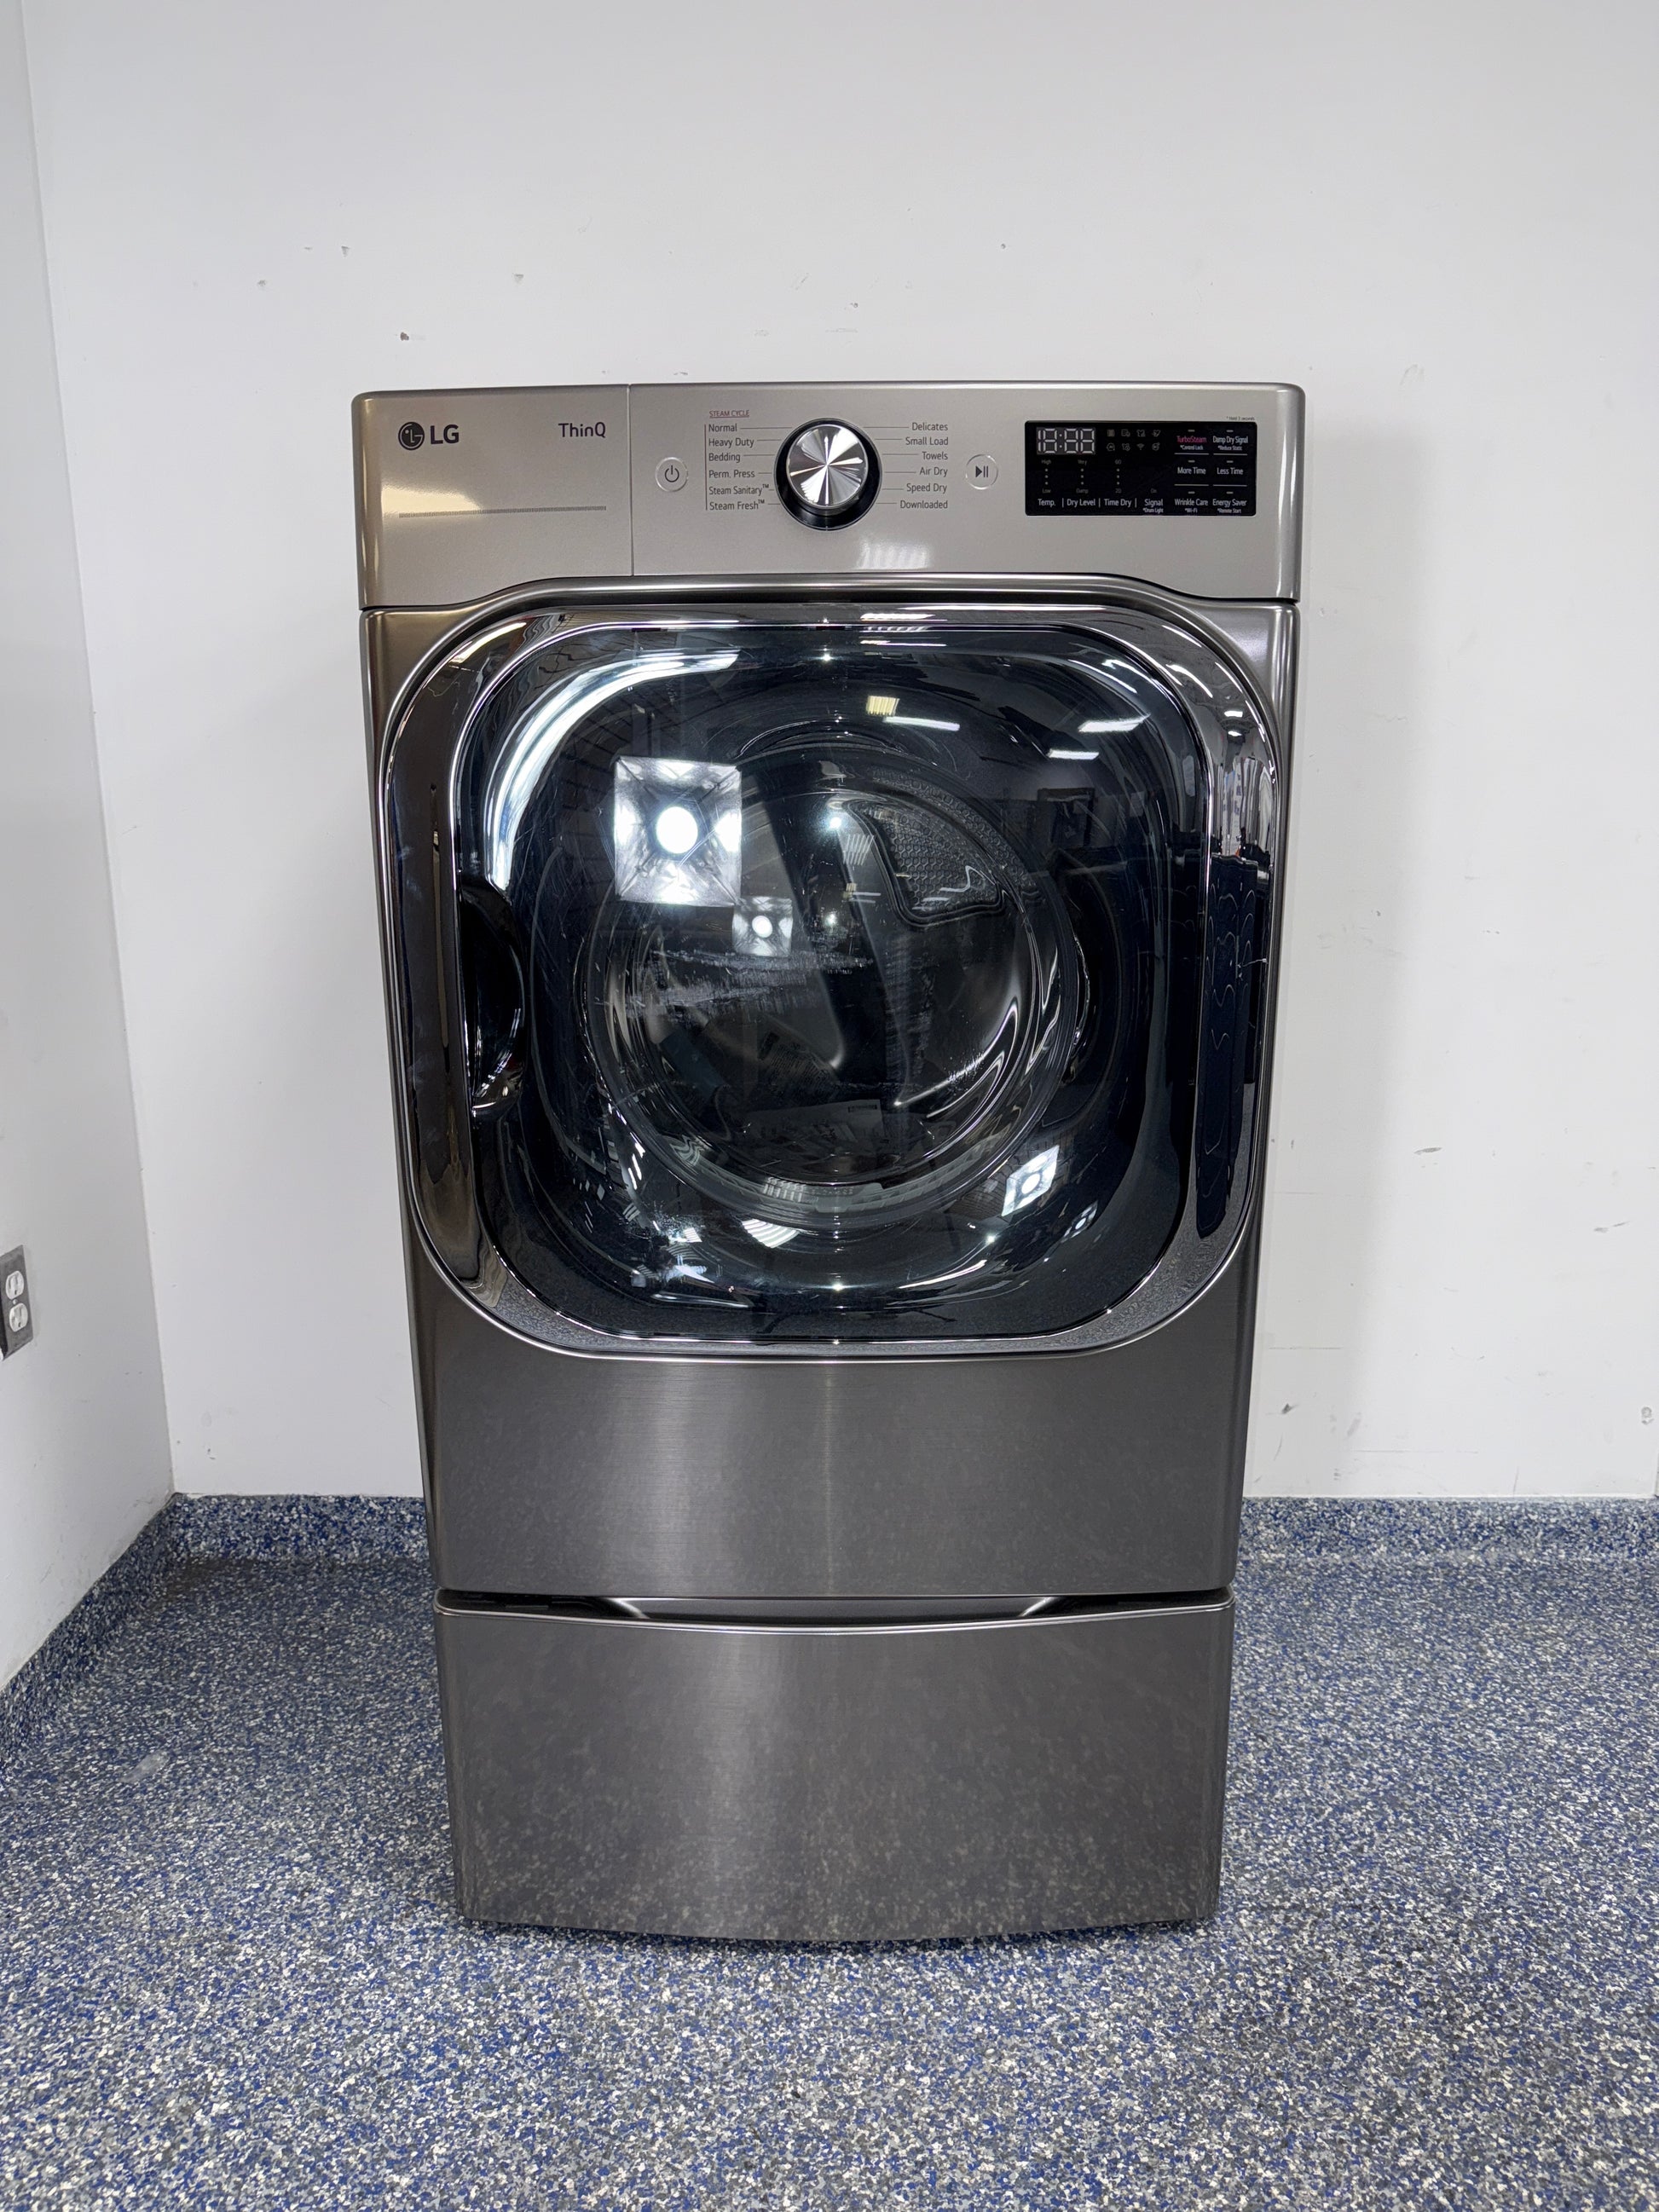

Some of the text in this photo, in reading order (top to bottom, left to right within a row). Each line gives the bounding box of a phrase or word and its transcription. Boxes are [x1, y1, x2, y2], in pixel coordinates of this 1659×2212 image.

[558, 422, 606, 438] ThinQ
[708, 423, 737, 432] Normal
[912, 422, 948, 431] Delicates
[430, 424, 460, 445] LG
[708, 438, 754, 448] Heavy Duty
[905, 436, 948, 445] Small Load
[1213, 436, 1225, 445] Damp
[1235, 436, 1249, 445] Signal
[708, 453, 740, 463] Bedding
[922, 451, 948, 460] Towels
[709, 470, 755, 478] Perm. Press
[919, 466, 948, 477] Air Dry
[709, 486, 731, 495] Steam
[907, 482, 947, 494] Speed Dry
[710, 502, 734, 510] Steam
[900, 500, 948, 508] Downloaded
[1038, 498, 1056, 508] Temp.
[1067, 499, 1078, 508] Dry
[1120, 499, 1132, 508] Dry
[1145, 498, 1163, 507] Signal
[1213, 499, 1231, 507] Energy
